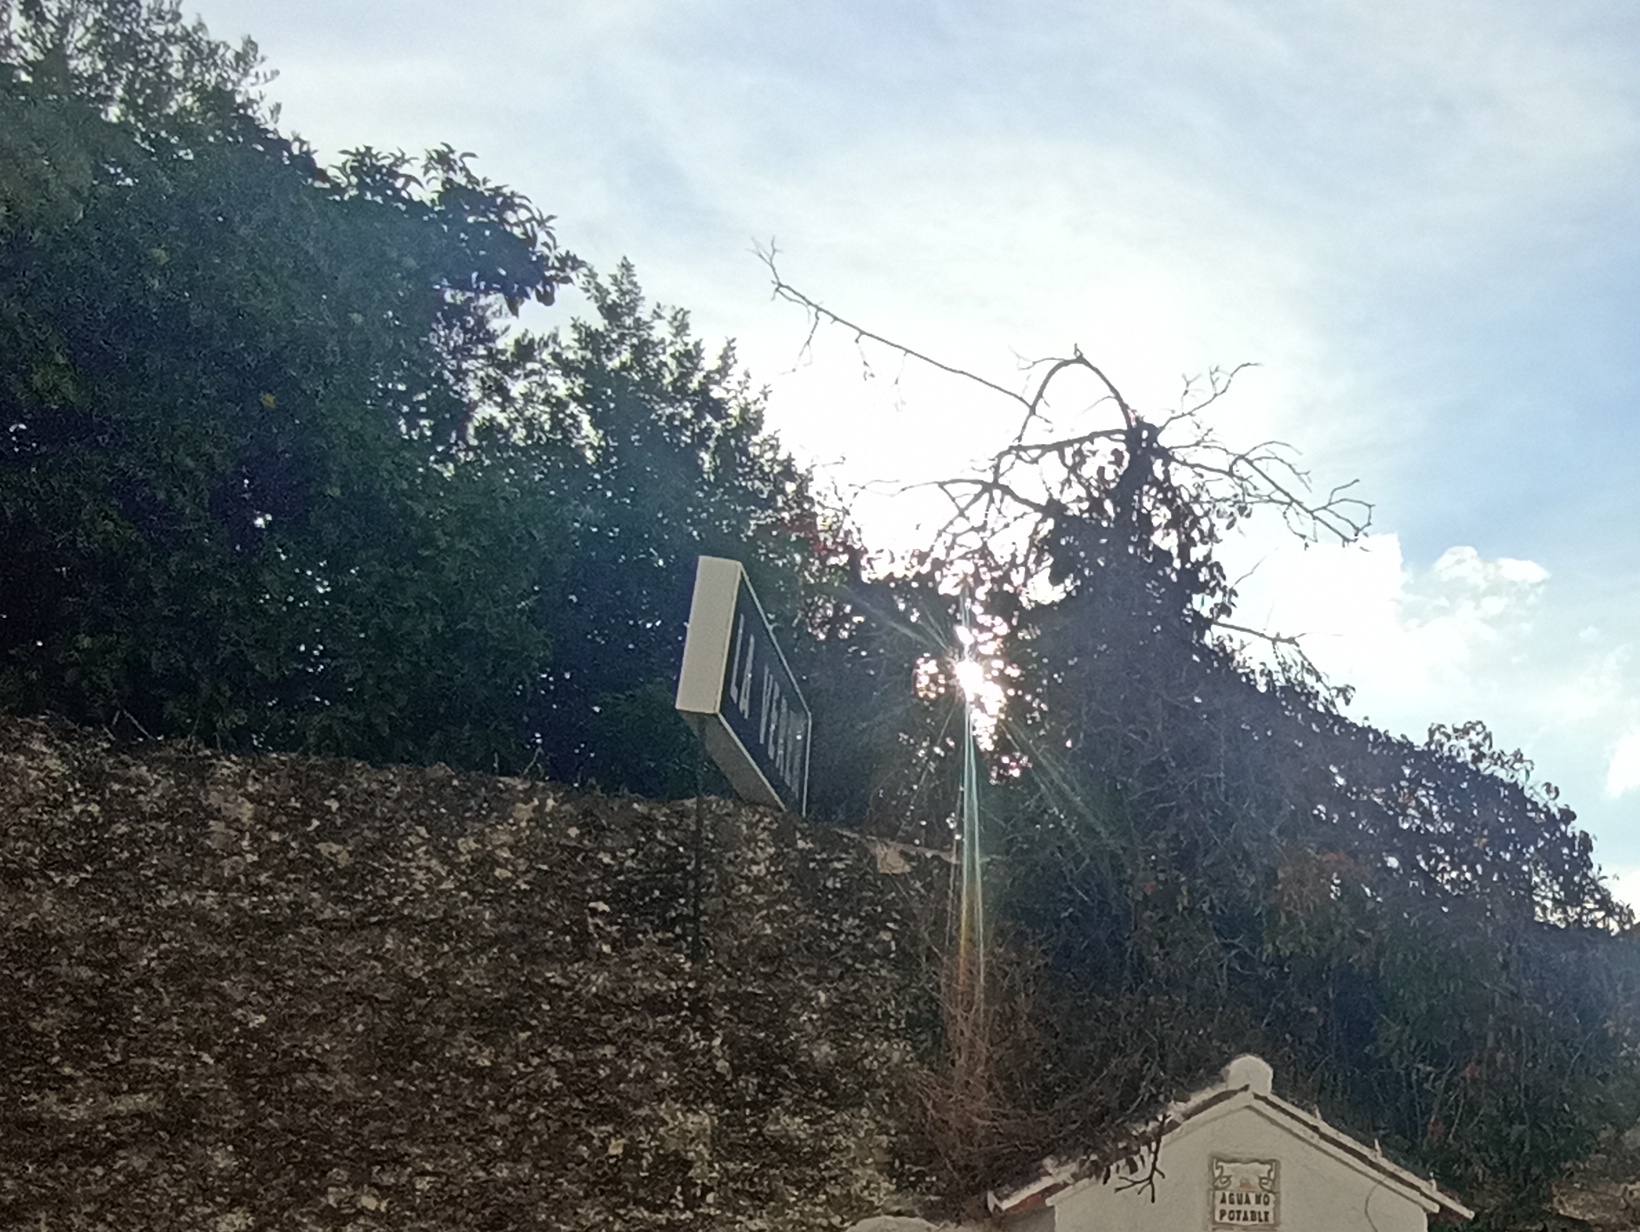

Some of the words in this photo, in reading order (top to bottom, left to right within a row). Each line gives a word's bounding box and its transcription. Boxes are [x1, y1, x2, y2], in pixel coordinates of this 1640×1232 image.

[729, 613, 756, 720] LA
[1220, 1192, 1251, 1206] AGUA
[1255, 1193, 1271, 1206] NO
[1219, 1209, 1270, 1223] POTABLE
